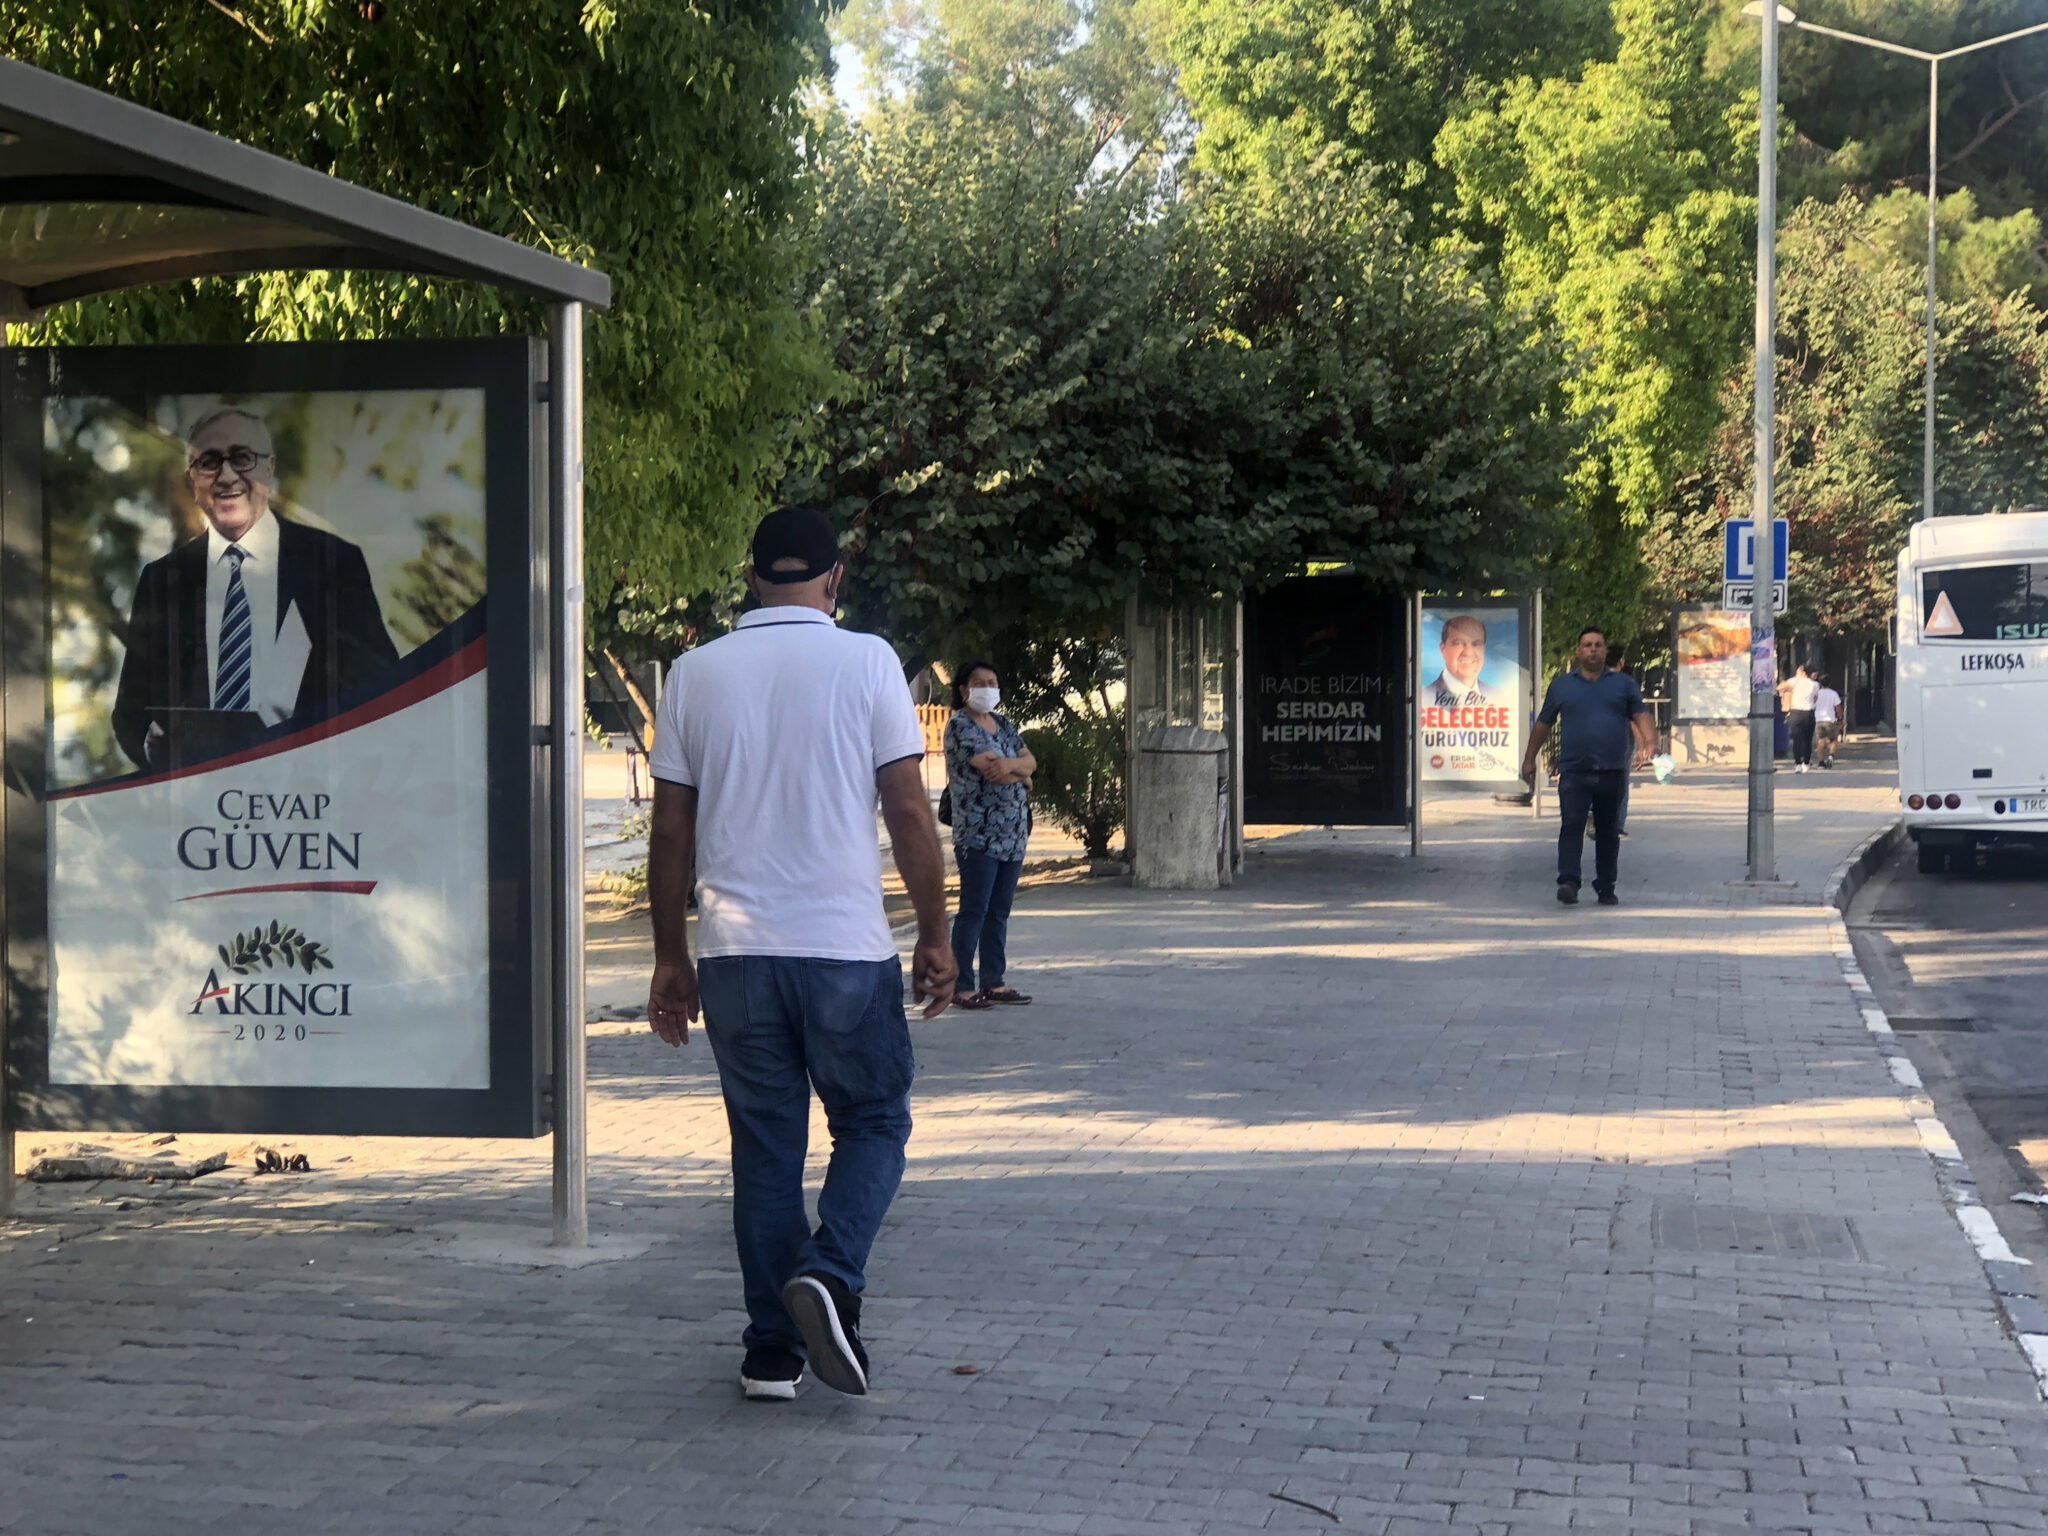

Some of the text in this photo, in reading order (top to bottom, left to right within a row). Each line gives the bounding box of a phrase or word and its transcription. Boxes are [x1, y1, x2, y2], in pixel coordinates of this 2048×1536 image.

[1961, 653, 2025, 674] LEFKOŞA
[1328, 673, 1382, 694] BİZİM
[1434, 690, 1488, 706] Yeni Bir
[1276, 701, 1366, 719] SERDAR
[1262, 721, 1382, 742] HEPİMİZİN
[1421, 731, 1510, 747] ÜRÜYORUZ
[217, 789, 331, 821] CEVAP
[177, 823, 362, 871] GÜVEN
[187, 968, 353, 1016] AKINCI
[234, 1024, 306, 1042] 2020
